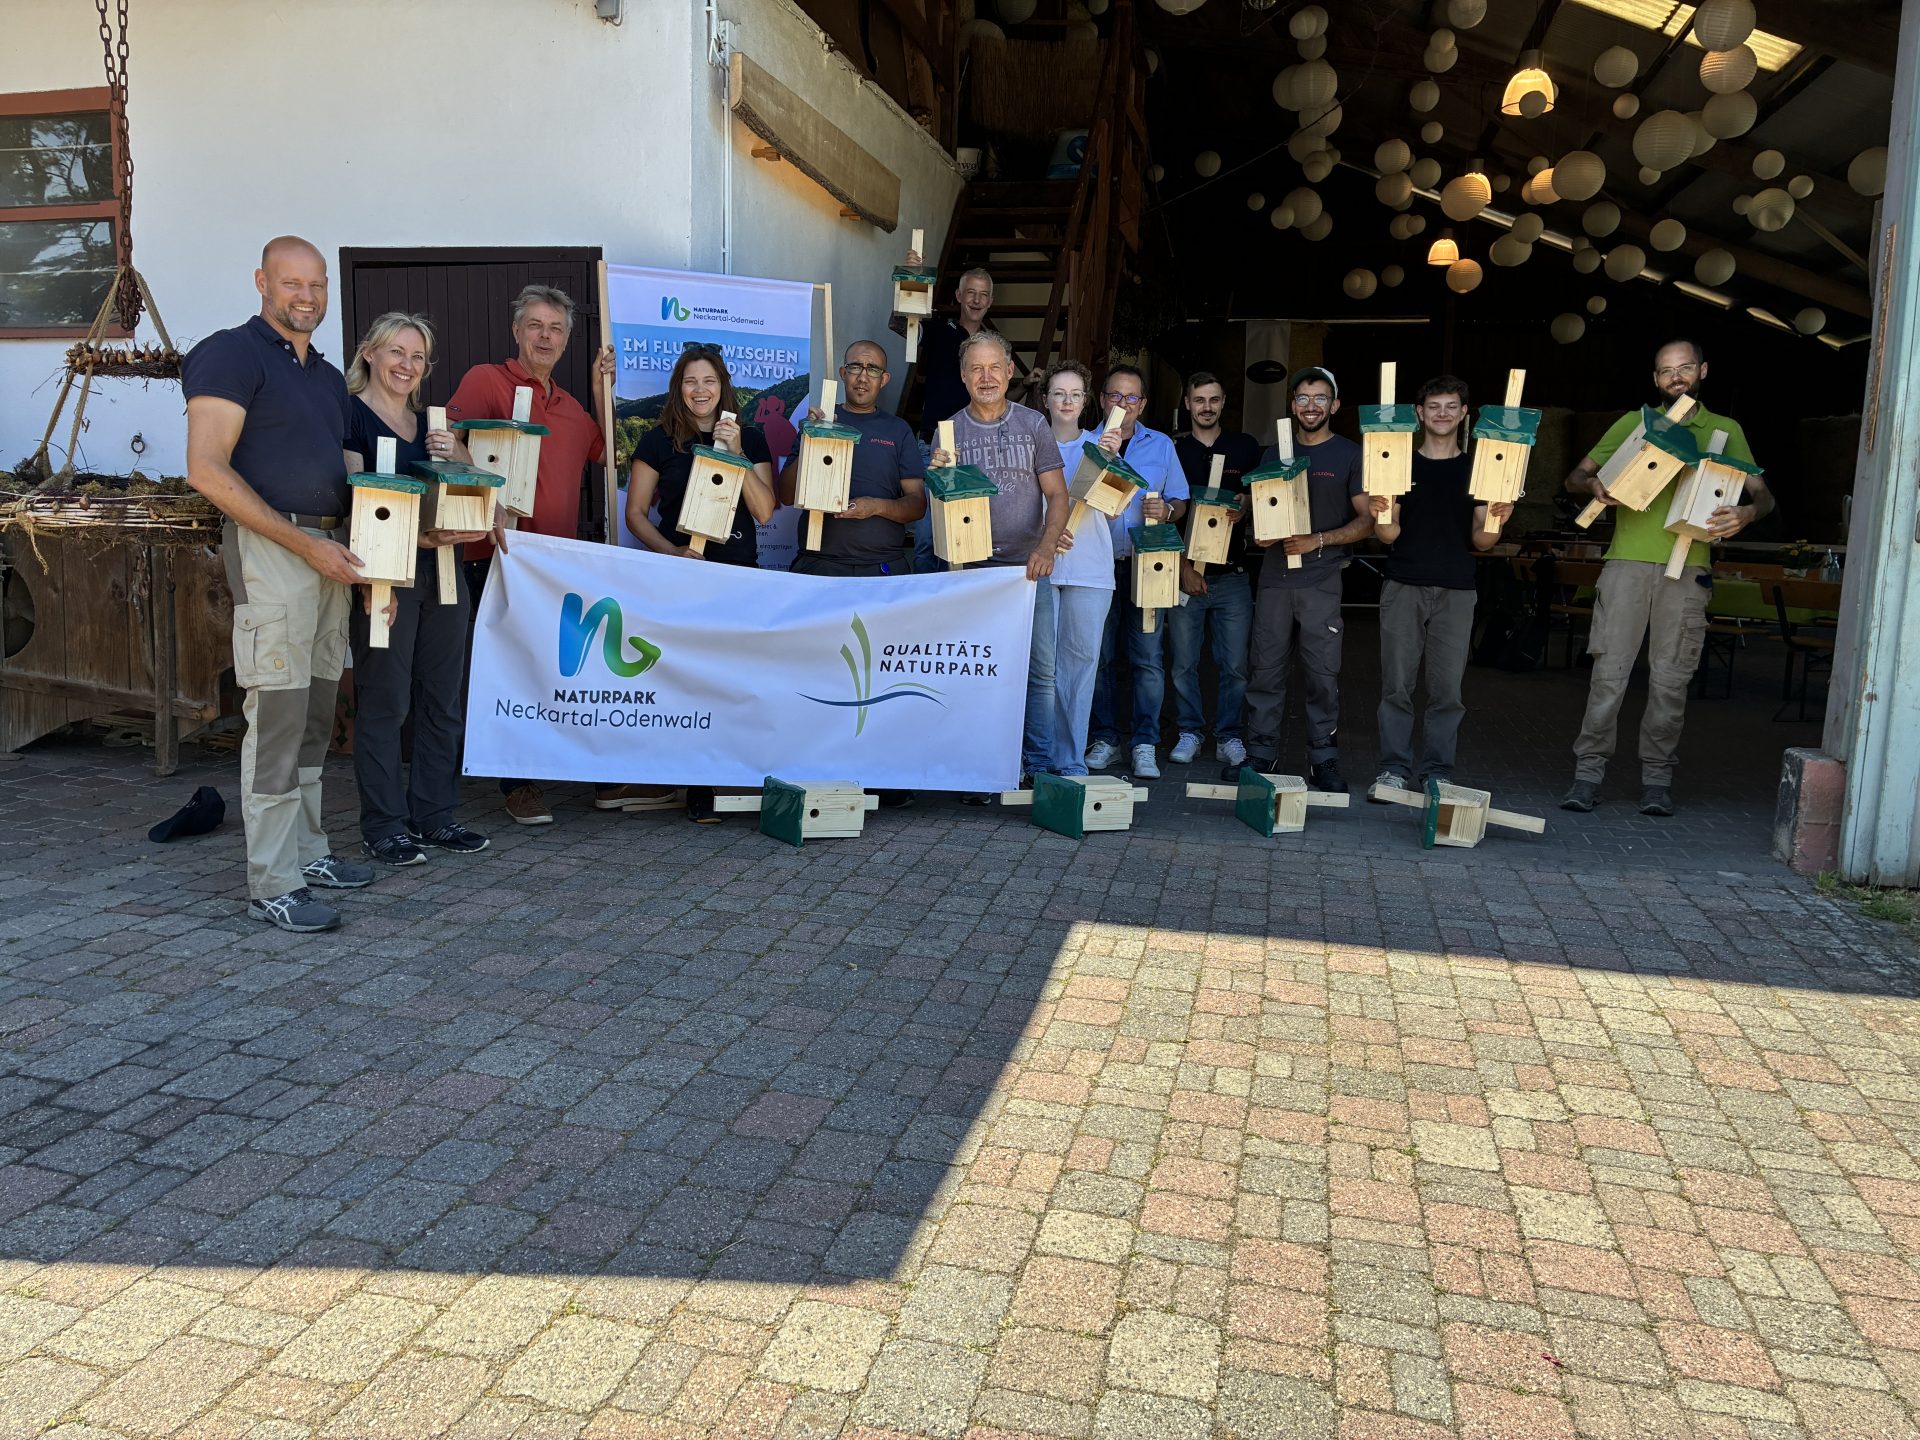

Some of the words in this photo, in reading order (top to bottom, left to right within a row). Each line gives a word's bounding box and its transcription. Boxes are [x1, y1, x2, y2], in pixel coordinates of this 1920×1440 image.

[693, 313, 764, 325] Neckartal-Odenwald
[623, 338, 647, 352] IM
[653, 340, 685, 355] FLU
[720, 344, 798, 363] WISCHEN
[623, 355, 678, 371] MENS
[742, 363, 796, 379] NATUR
[955, 435, 1032, 448] ENGINEERED
[957, 444, 1036, 472] UPERDRY
[1002, 470, 1031, 482] DUTY
[883, 641, 992, 658] QUALITÄTS
[880, 660, 998, 677] NATURPARK
[554, 689, 656, 704] NATURPARK
[495, 698, 711, 729] Neckartal-Odenwald
